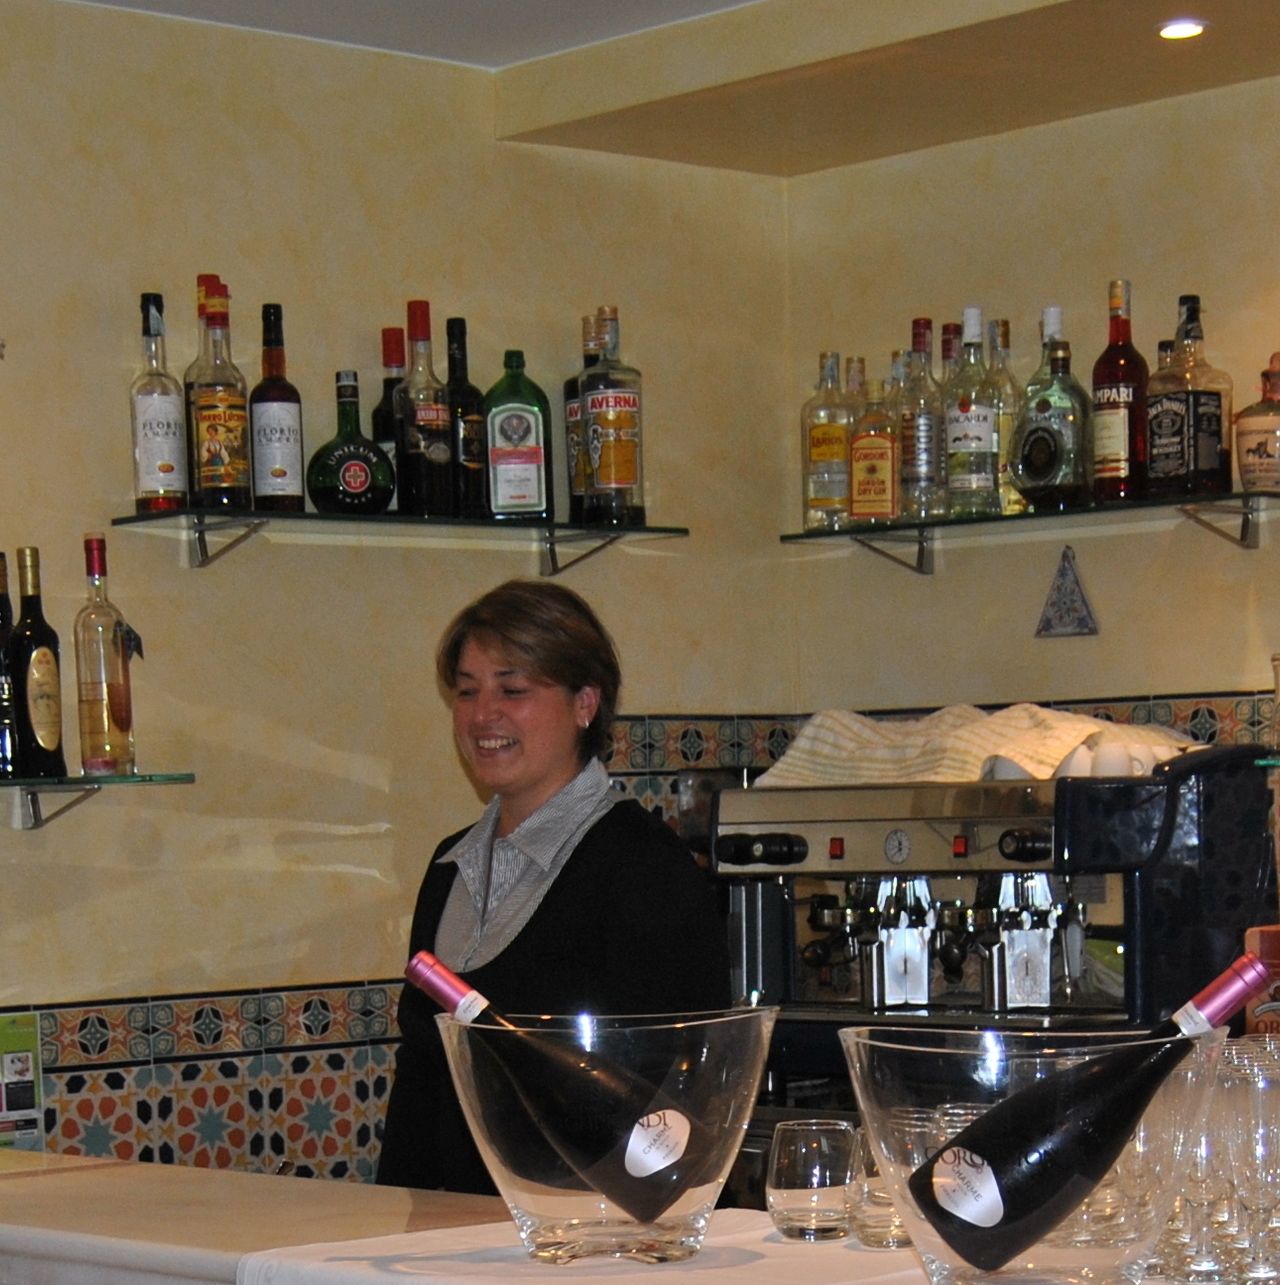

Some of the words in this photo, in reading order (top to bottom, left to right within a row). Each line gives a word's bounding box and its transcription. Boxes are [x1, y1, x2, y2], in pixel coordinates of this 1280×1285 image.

[590, 394, 640, 411] AVERNA
[1096, 387, 1134, 403] MPARI
[949, 413, 988, 425] BACARDI
[257, 426, 299, 437] FLORIO
[328, 444, 379, 466] UNICUM
[951, 1164, 984, 1203] CHARME
